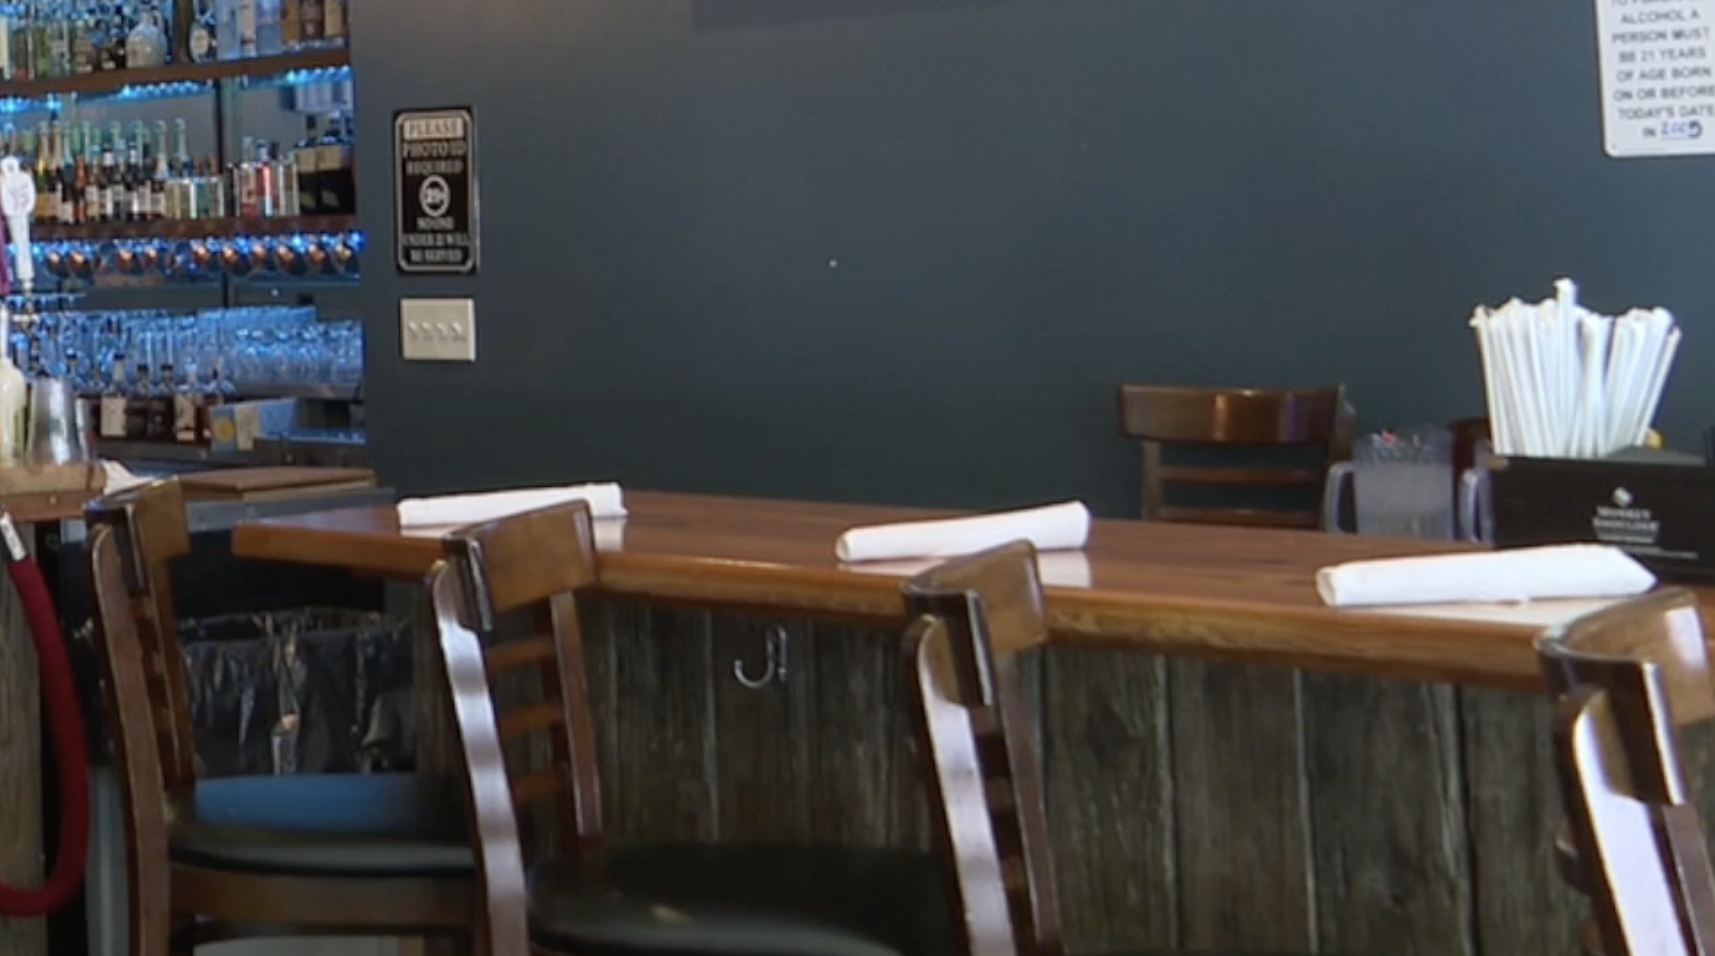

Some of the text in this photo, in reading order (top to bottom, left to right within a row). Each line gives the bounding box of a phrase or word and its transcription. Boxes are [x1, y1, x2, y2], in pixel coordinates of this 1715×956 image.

[1620, 8, 1701, 24] ALCOHOL A
[1611, 26, 1711, 44] PERSON MUST
[1618, 46, 1706, 63] BE 21 YEARS
[1616, 65, 1712, 83] OF AGE BORN
[1613, 84, 1715, 102] ON OR BEFORE
[1617, 105, 1675, 120] TODAY'S
[408, 120, 458, 137] PLEASE
[1642, 126, 1657, 138] IN
[403, 141, 447, 158] PHOTO
